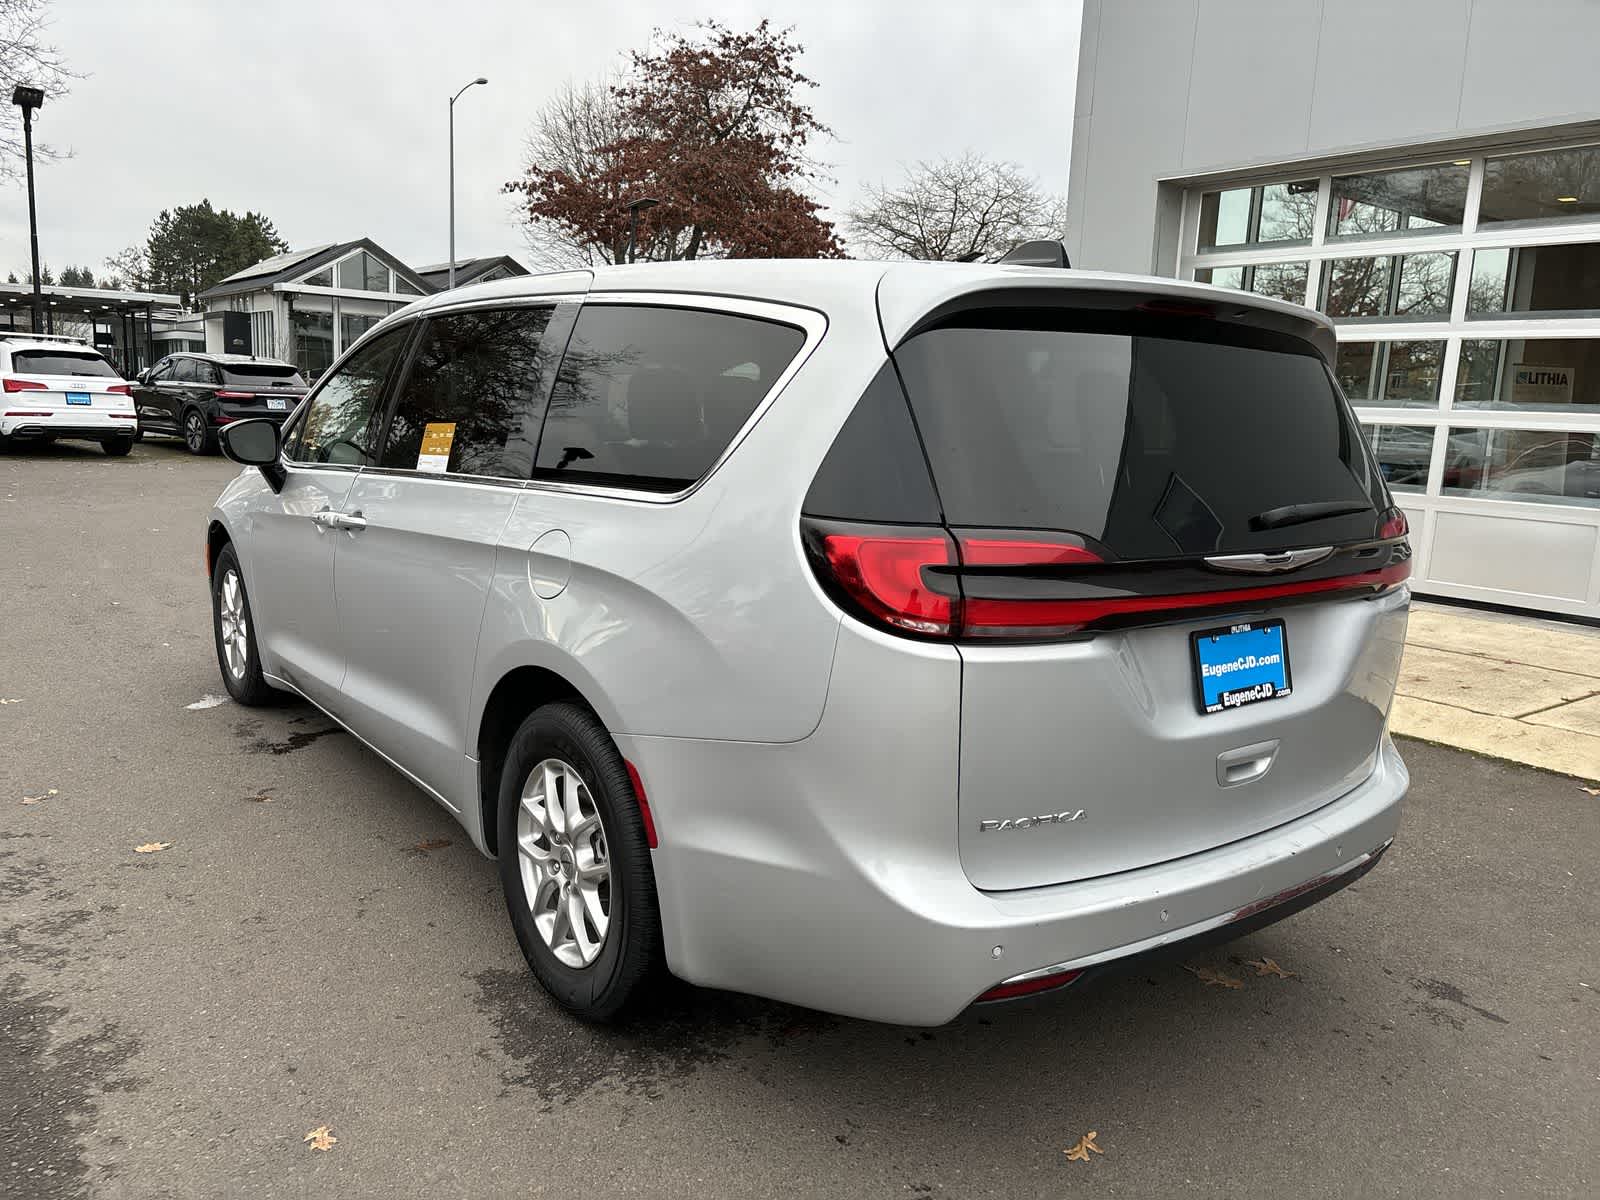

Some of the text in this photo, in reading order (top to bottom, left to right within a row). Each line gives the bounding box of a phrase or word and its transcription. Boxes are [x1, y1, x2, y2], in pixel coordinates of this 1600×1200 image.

[1528, 372, 1568, 385] LITHIA
[1201, 654, 1280, 677] EugeneCJD.com
[1223, 683, 1273, 707] EugeneCJD
[980, 808, 1087, 832] PACIFICA
